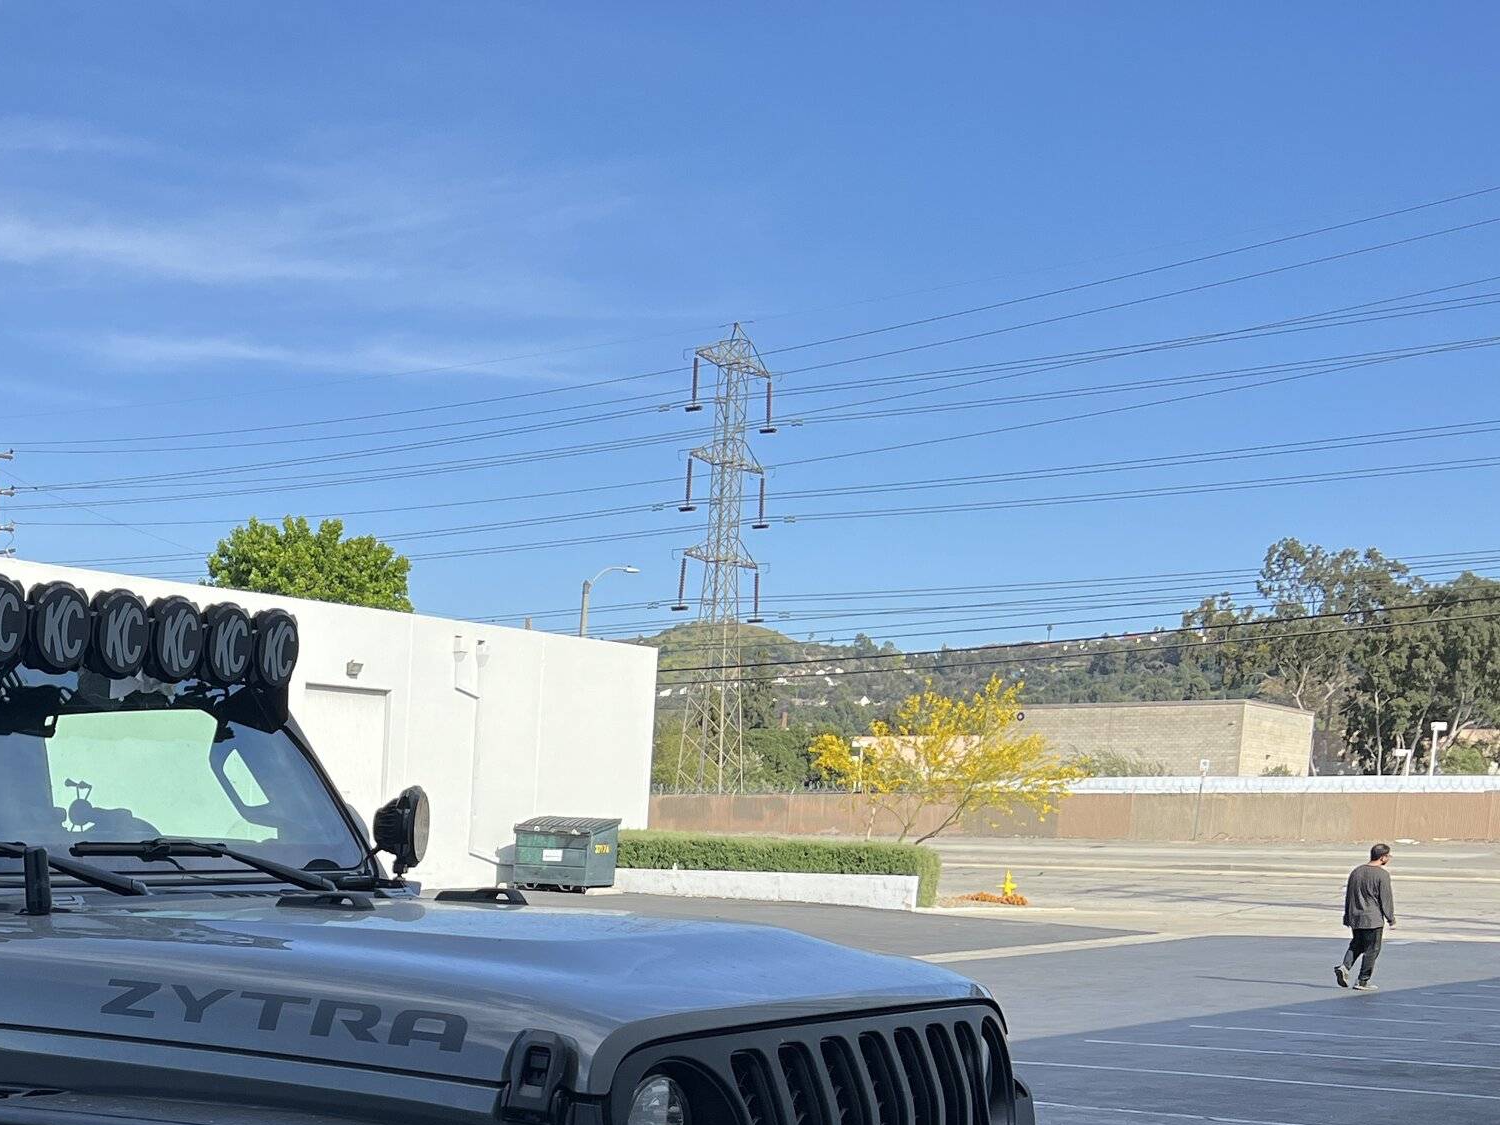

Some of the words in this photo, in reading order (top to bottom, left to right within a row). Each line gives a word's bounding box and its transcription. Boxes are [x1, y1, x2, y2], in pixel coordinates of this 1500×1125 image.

[44, 595, 84, 658] KC
[106, 602, 143, 663] KC
[162, 608, 197, 667] KC
[216, 615, 248, 675] KC
[264, 620, 295, 680] KC
[101, 978, 468, 1053] ZYTRA
